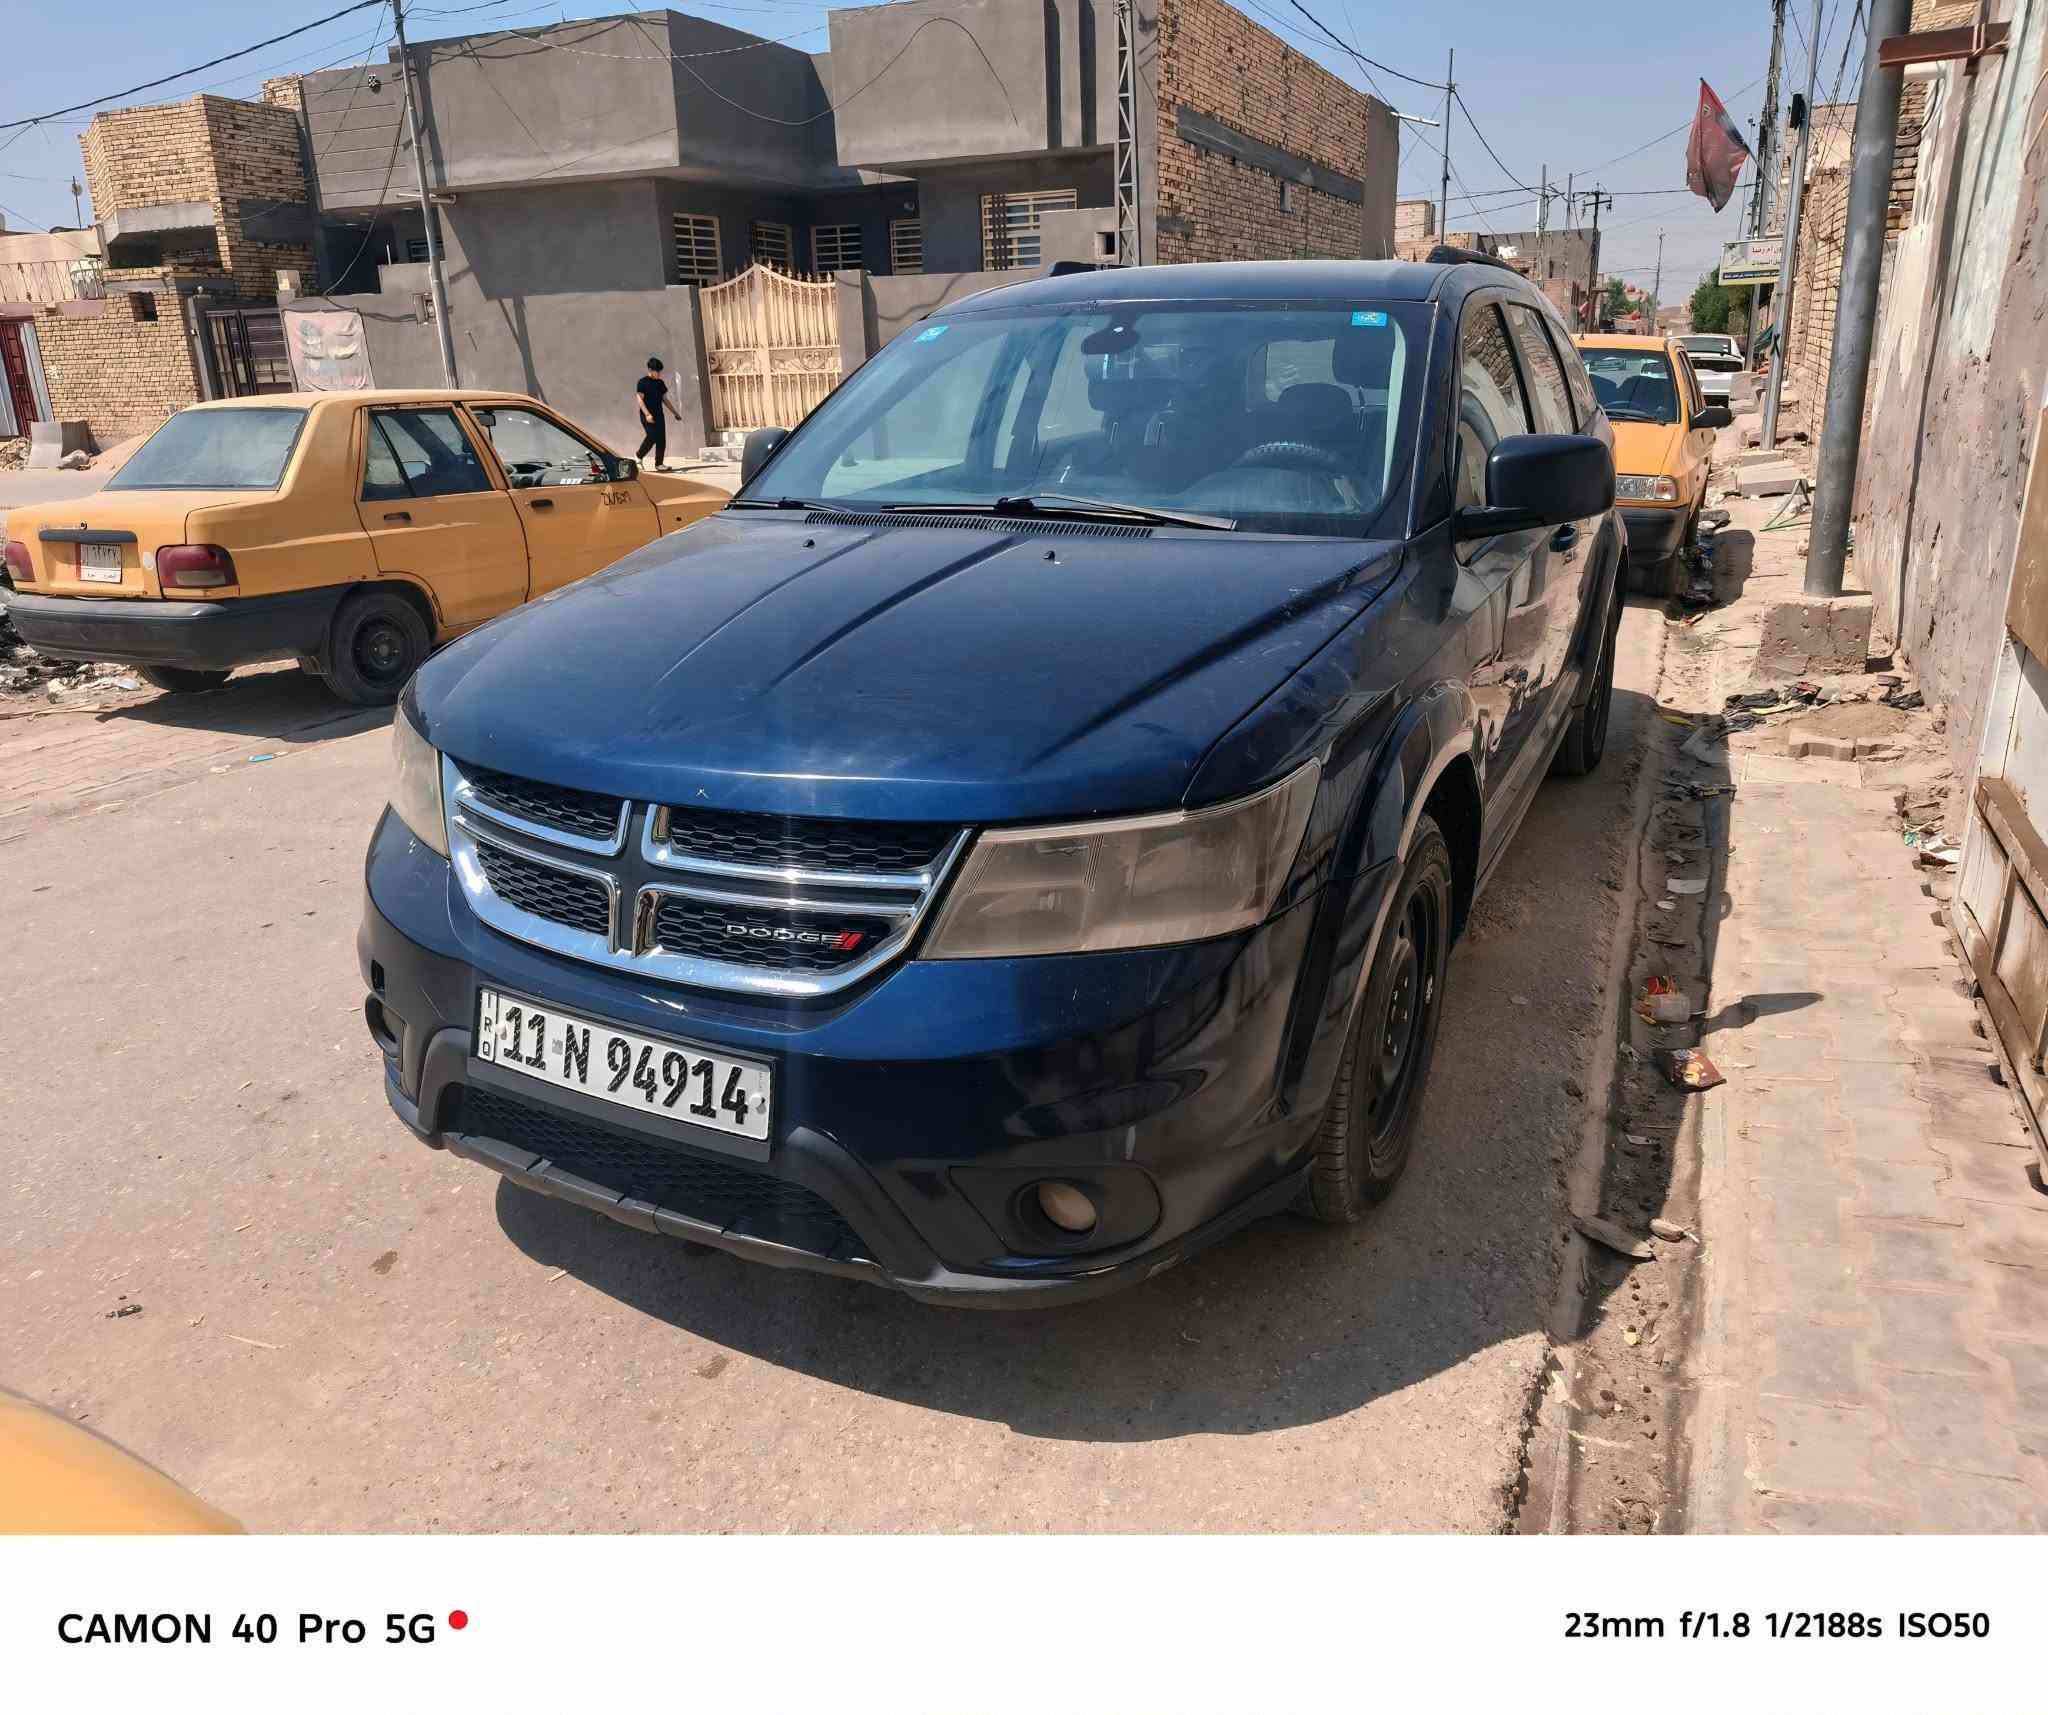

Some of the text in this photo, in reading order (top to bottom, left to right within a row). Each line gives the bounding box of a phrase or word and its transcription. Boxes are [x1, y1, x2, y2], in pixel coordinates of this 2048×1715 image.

[726, 924, 844, 946] DODGE
[482, 990, 493, 1058] IRQ
[503, 1006, 749, 1125] 11 N 94914
